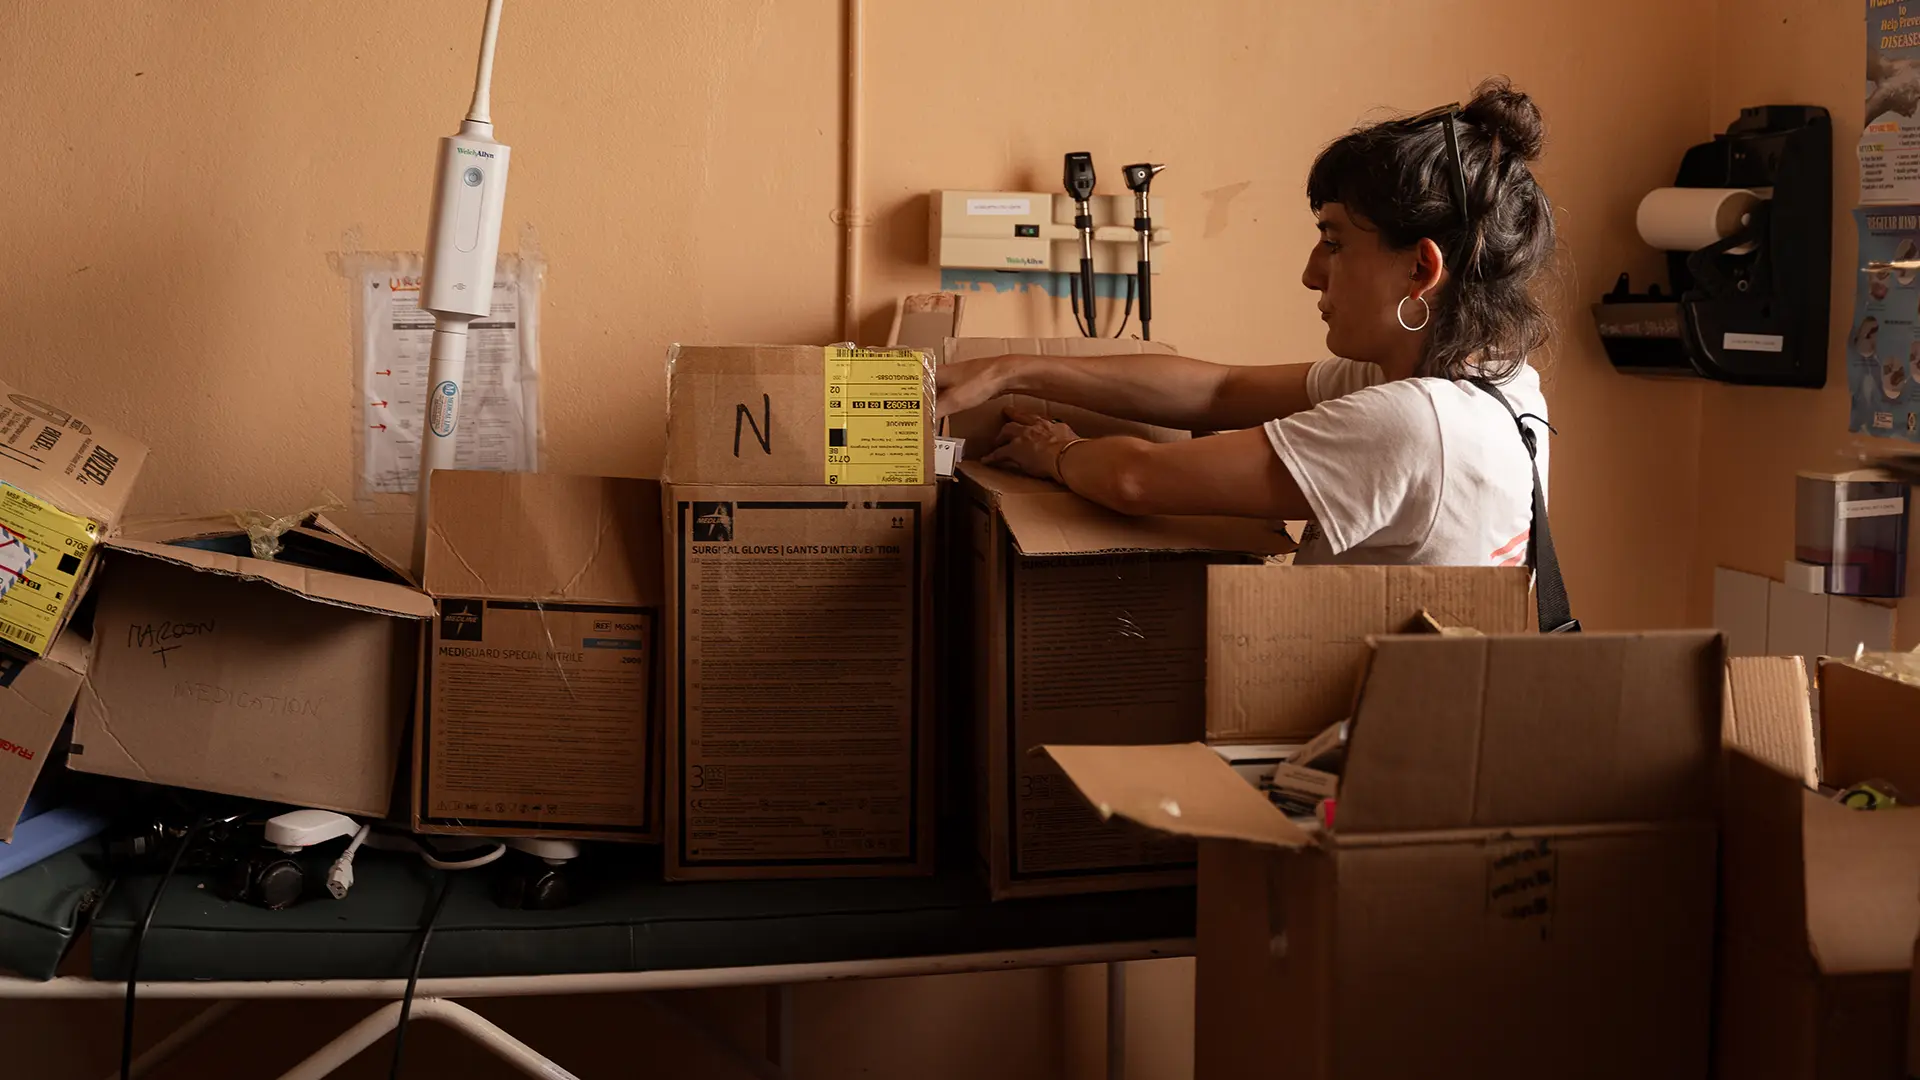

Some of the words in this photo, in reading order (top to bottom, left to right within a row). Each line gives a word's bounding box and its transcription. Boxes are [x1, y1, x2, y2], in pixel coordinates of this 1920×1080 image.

[1899, 6, 1907, 16] to
[1881, 18, 1899, 32] Help
[1898, 215, 1917, 230] HAND
[830, 386, 841, 394] 02
[886, 401, 918, 409] 215092
[733, 393, 772, 458] N
[828, 455, 851, 463] Q712
[882, 475, 903, 483] Supply
[6, 490, 22, 501] MSF
[21, 496, 44, 512] Supply
[65, 537, 89, 552] Q706
[741, 545, 779, 555] GLOVES
[786, 545, 819, 555] GANTS
[46, 603, 58, 614] 02
[444, 614, 479, 623] MEDLINE
[438, 646, 500, 659] MEDIGUARD
[502, 649, 543, 661] SPECIAL
[546, 651, 585, 663] NITRILE
[172, 680, 325, 720] MEDICATION
[0, 738, 36, 760] FRAG
